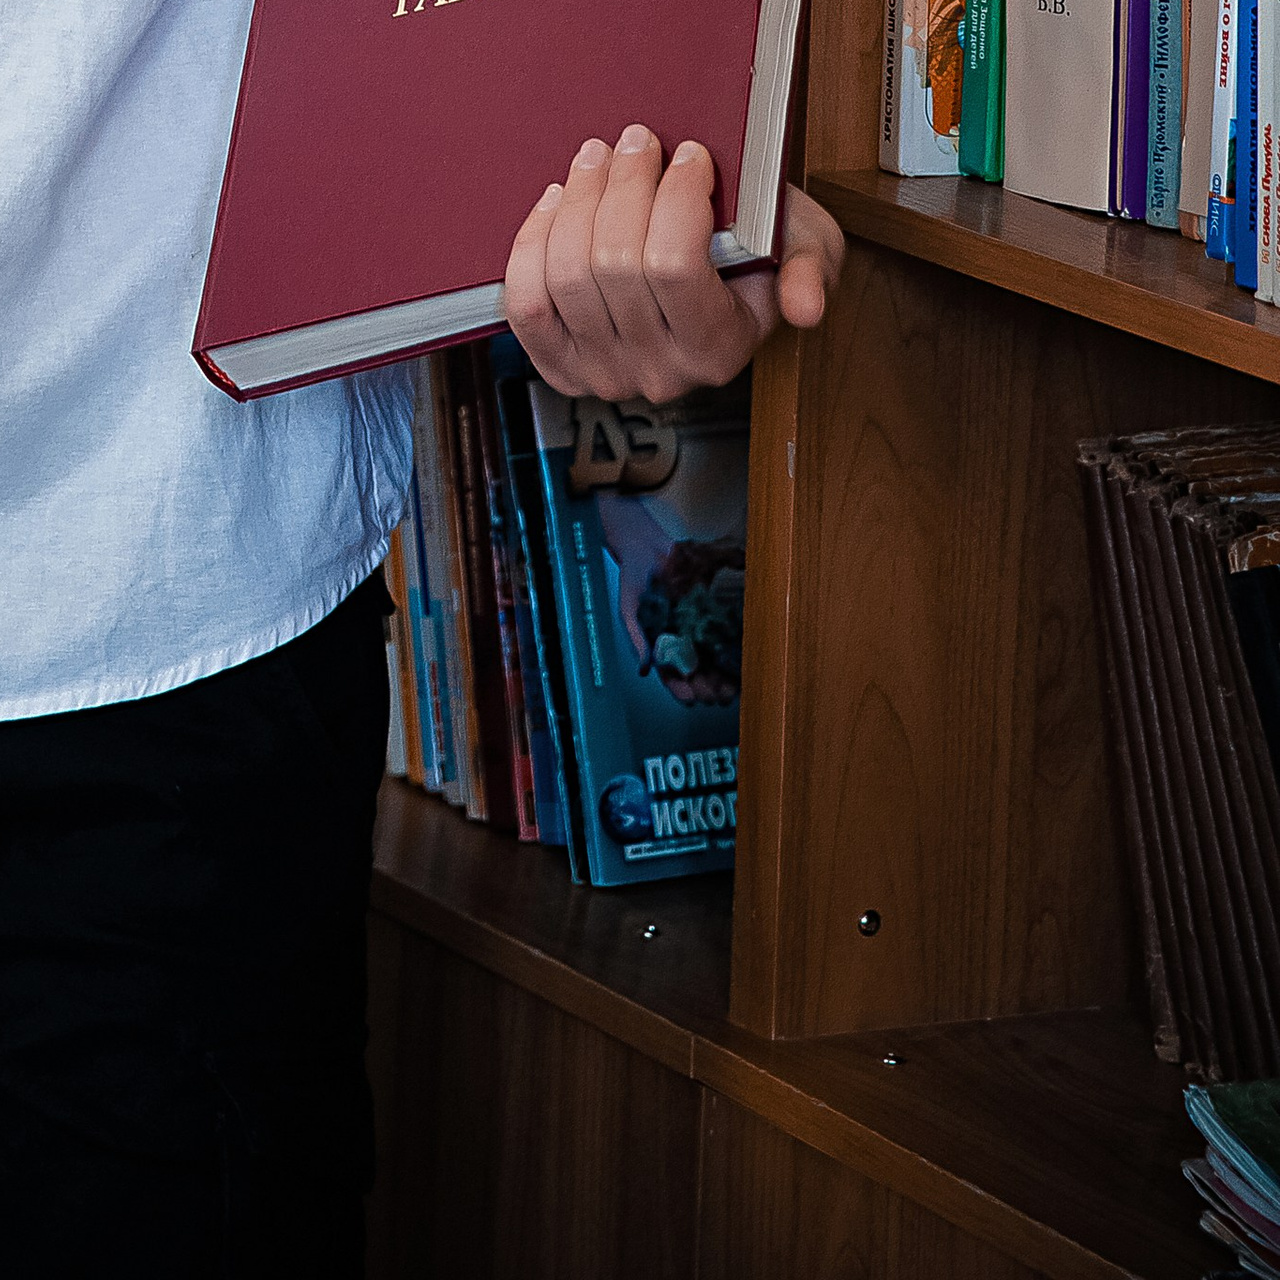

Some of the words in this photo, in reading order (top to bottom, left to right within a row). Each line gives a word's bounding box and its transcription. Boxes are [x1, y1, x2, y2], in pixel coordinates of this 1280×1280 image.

[970, 9, 980, 32] для
[978, 6, 989, 60] Зощенко
[1222, 13, 1231, 27] О
[970, 33, 980, 70] детей
[1219, 29, 1231, 89] ВОЙНЕ
[883, 37, 895, 144] ХРЕСТОМАТИЯ
[1152, 84, 1171, 165] Изюмский
[1151, 167, 1171, 209] Борис
[1210, 173, 1222, 237] ОНИКС
[644, 747, 738, 794] ПОЛЕЗ
